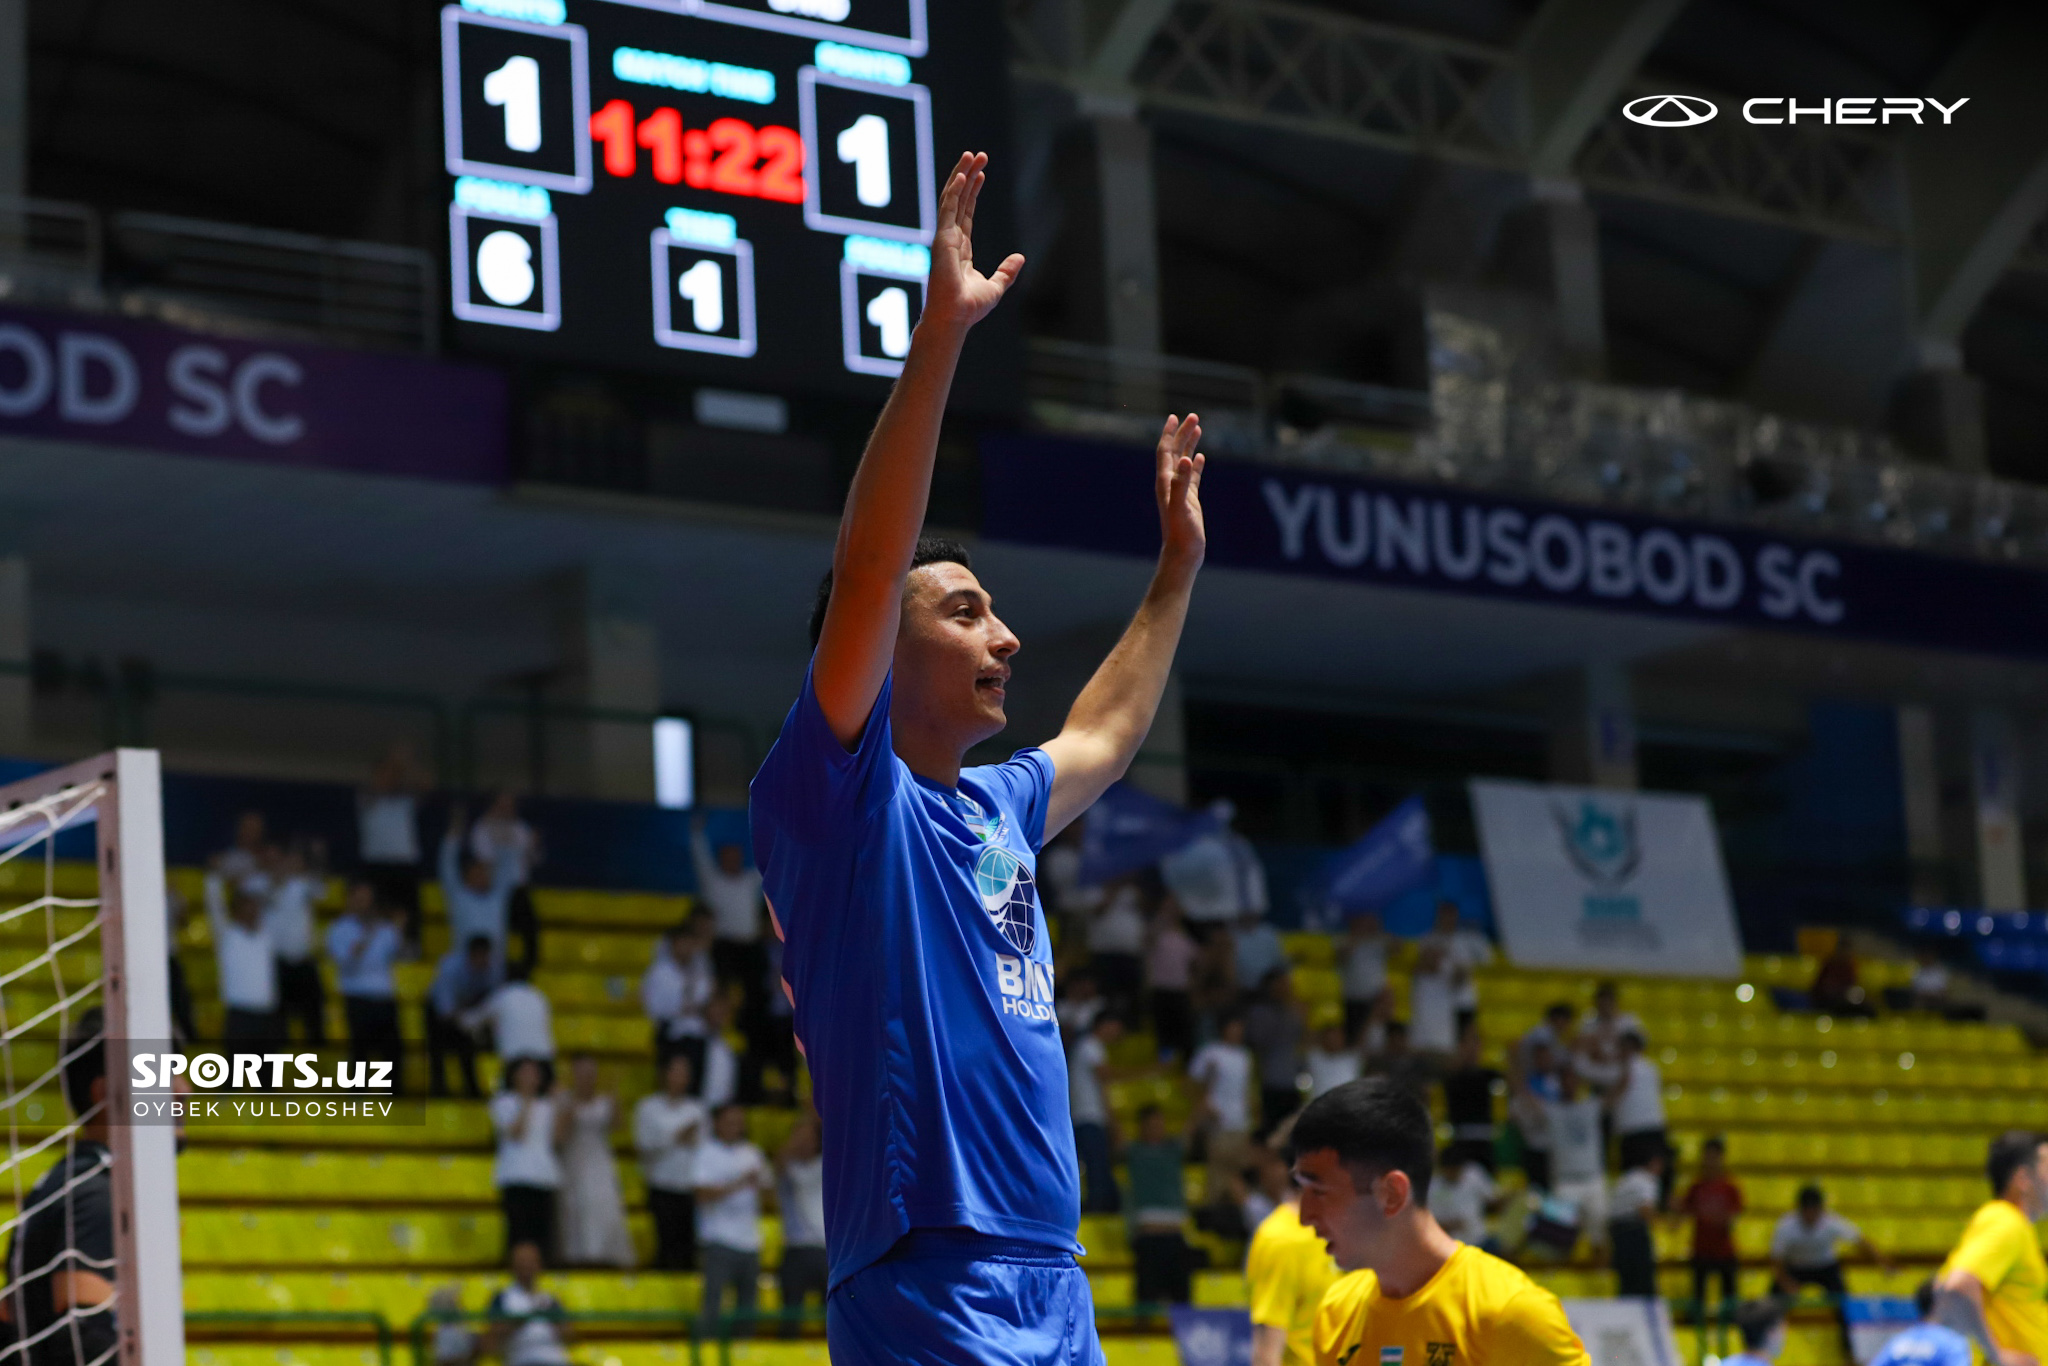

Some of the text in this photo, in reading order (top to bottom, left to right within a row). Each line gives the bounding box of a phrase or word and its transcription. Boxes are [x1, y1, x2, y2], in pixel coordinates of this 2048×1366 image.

[484, 55, 542, 153] 1
[590, 99, 808, 204] 11:22
[837, 114, 892, 208] 1
[477, 230, 535, 306] 6
[679, 260, 724, 332] 1
[867, 287, 910, 358] 1
[168, 345, 306, 443] SC
[1263, 478, 1844, 623] YUNUSOBOD SC
